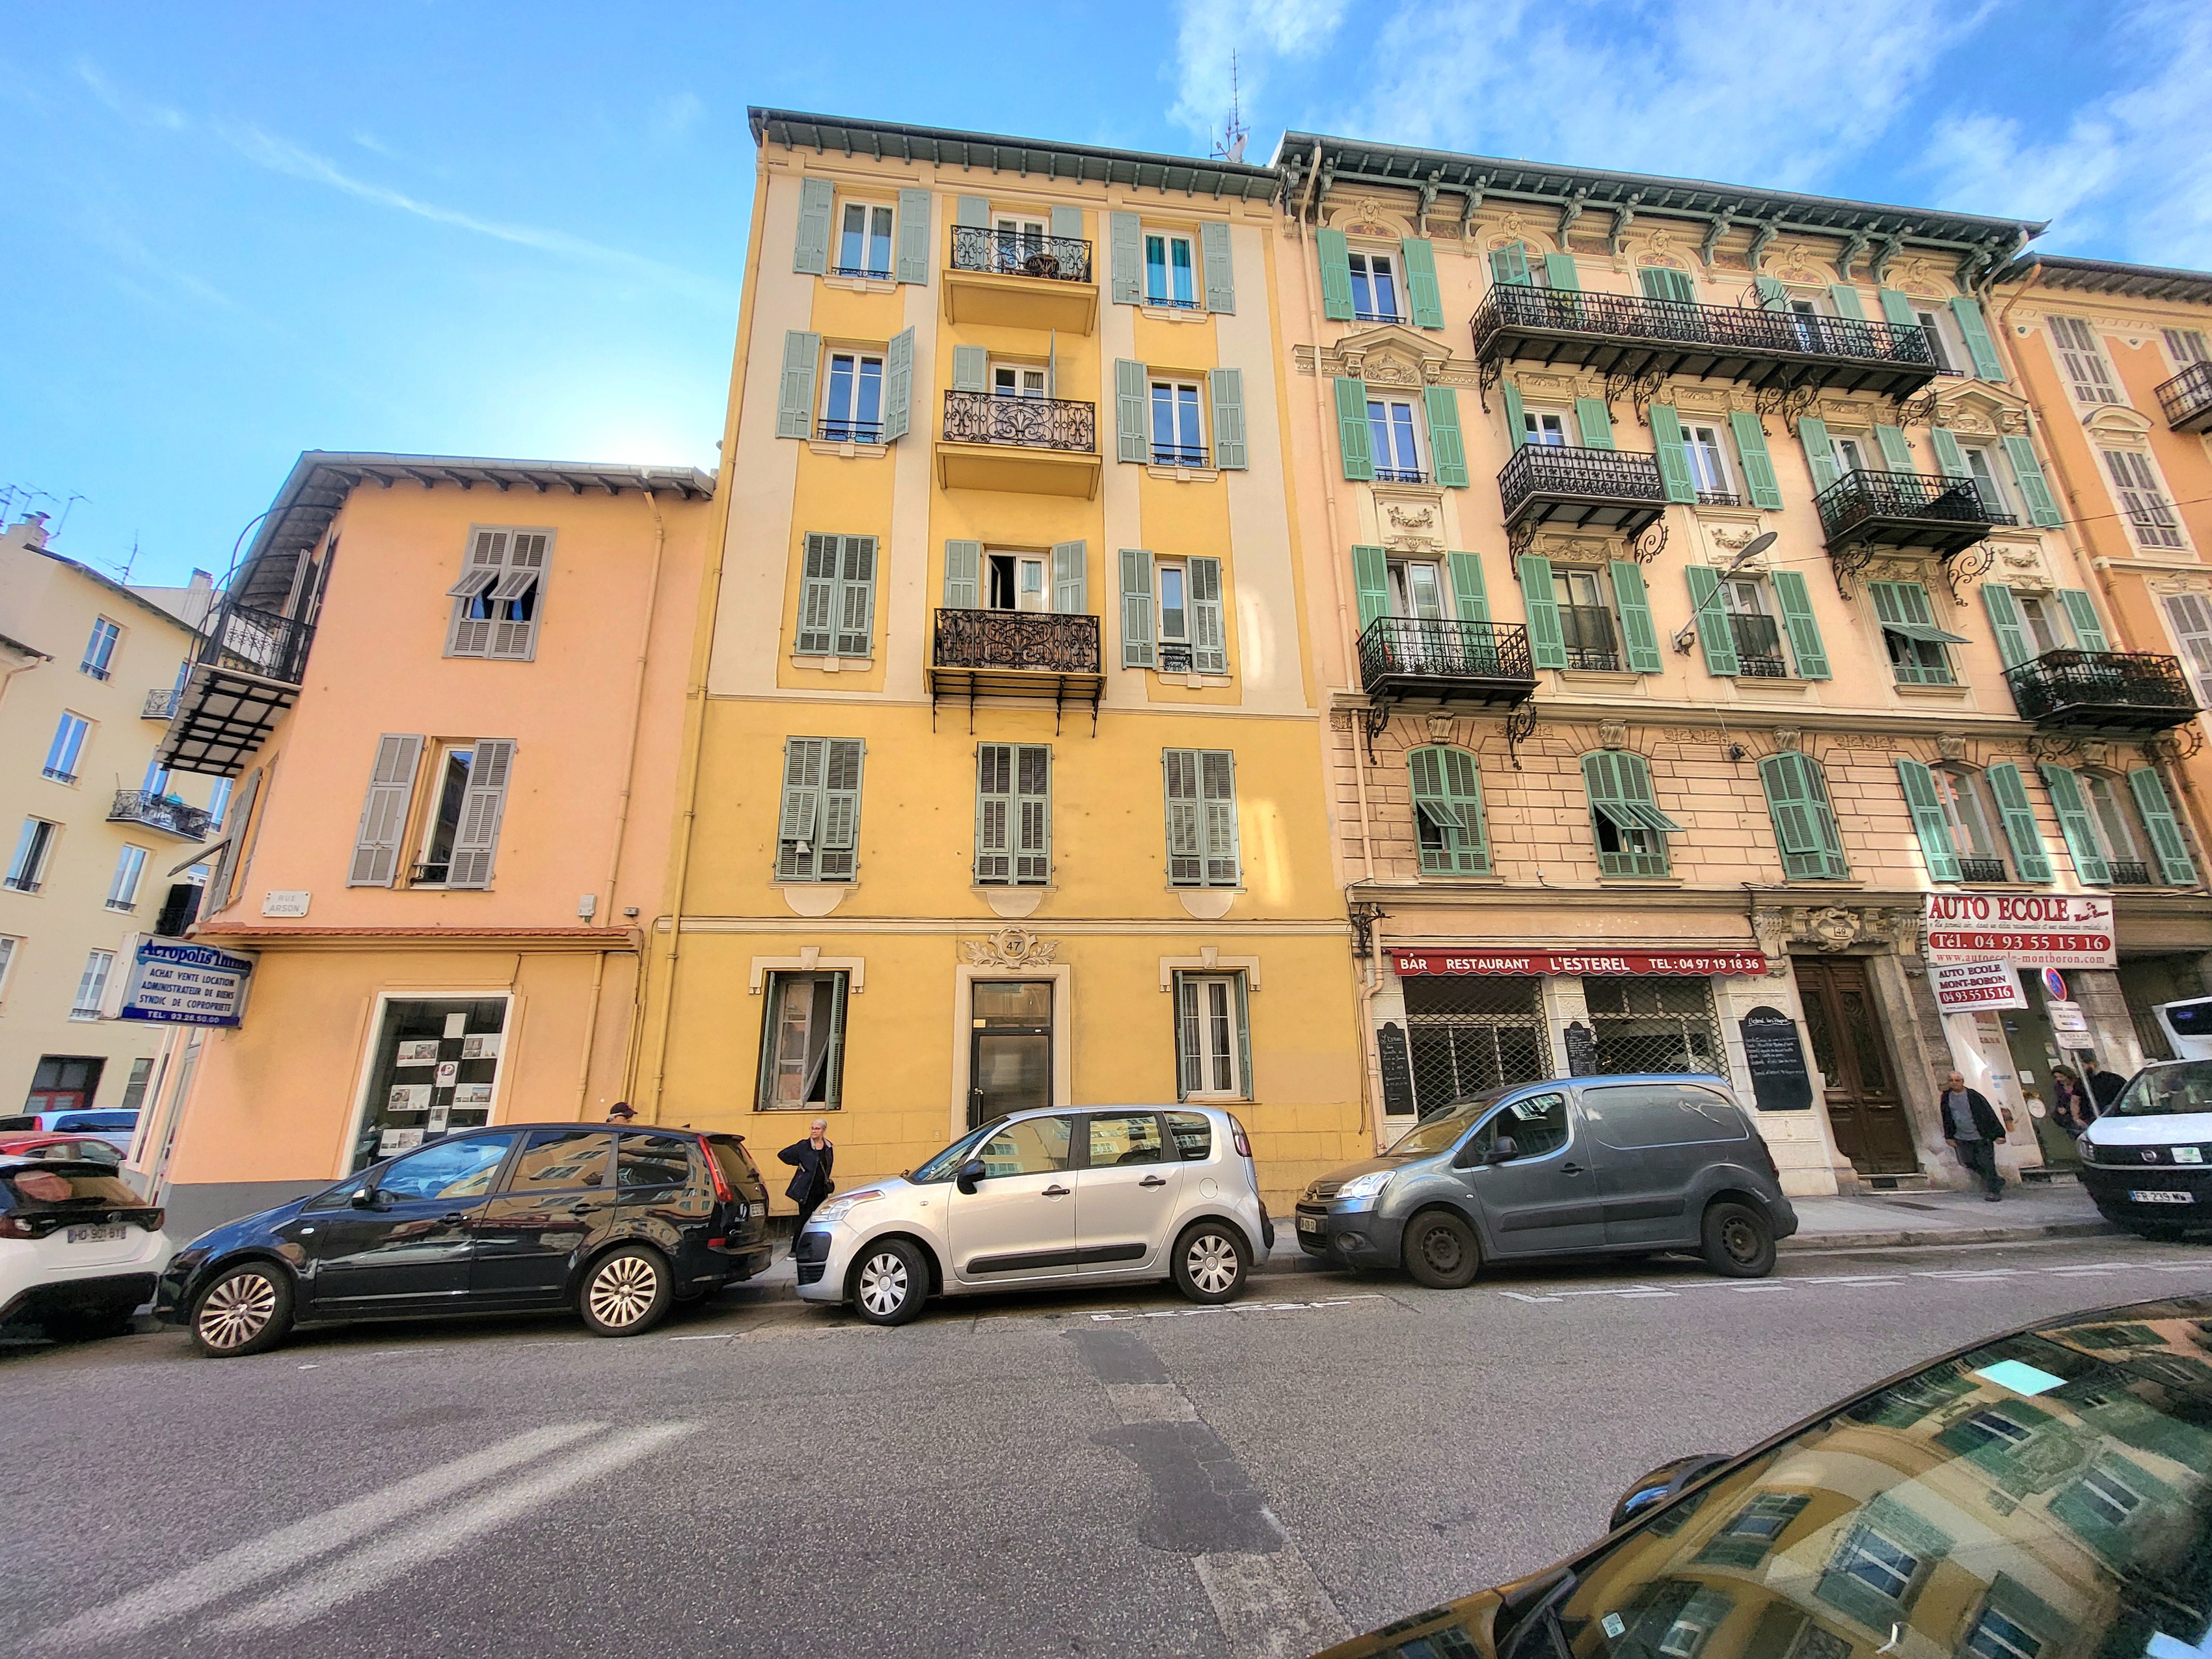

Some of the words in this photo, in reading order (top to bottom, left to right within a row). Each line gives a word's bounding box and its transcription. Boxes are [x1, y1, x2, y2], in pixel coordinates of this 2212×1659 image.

[1928, 896, 1989, 920] AUTO
[1997, 897, 2070, 921] ECOLE
[1006, 941, 1021, 951] 47
[1935, 934, 1967, 948] Tél.
[1974, 935, 1996, 949] 04
[2002, 936, 2023, 949] 93
[2028, 936, 2050, 949] 55
[2058, 936, 2076, 950] 15
[2084, 937, 2104, 950] 16
[1399, 958, 1428, 969] BAR
[1446, 958, 1530, 969] RESTAURANT
[1549, 957, 1630, 971] L'ESTEREL
[1679, 958, 1694, 969] 04
[1696, 958, 1710, 969] 97
[1712, 958, 1726, 969] 19
[1729, 958, 1743, 969] 18
[1745, 958, 1759, 969] 36
[1939, 968, 1965, 978] AUTO
[1967, 964, 2002, 975] ECOLE
[150, 968, 174, 978] ACHAT
[178, 971, 199, 982] VENTE
[202, 975, 235, 987] LOCATION
[1939, 975, 2006, 990] MONT-BORON
[141, 981, 202, 995] ADMINISTRATEUR
[1942, 992, 1954, 1002] 04
[1955, 991, 1967, 1001] 93
[1969, 990, 1982, 1000] 55
[1983, 988, 1995, 999] 15
[1997, 986, 2011, 997] 16
[139, 995, 167, 1005] SYNDIC
[172, 998, 182, 1006] DE
[187, 999, 232, 1012] COPROPRIETE
